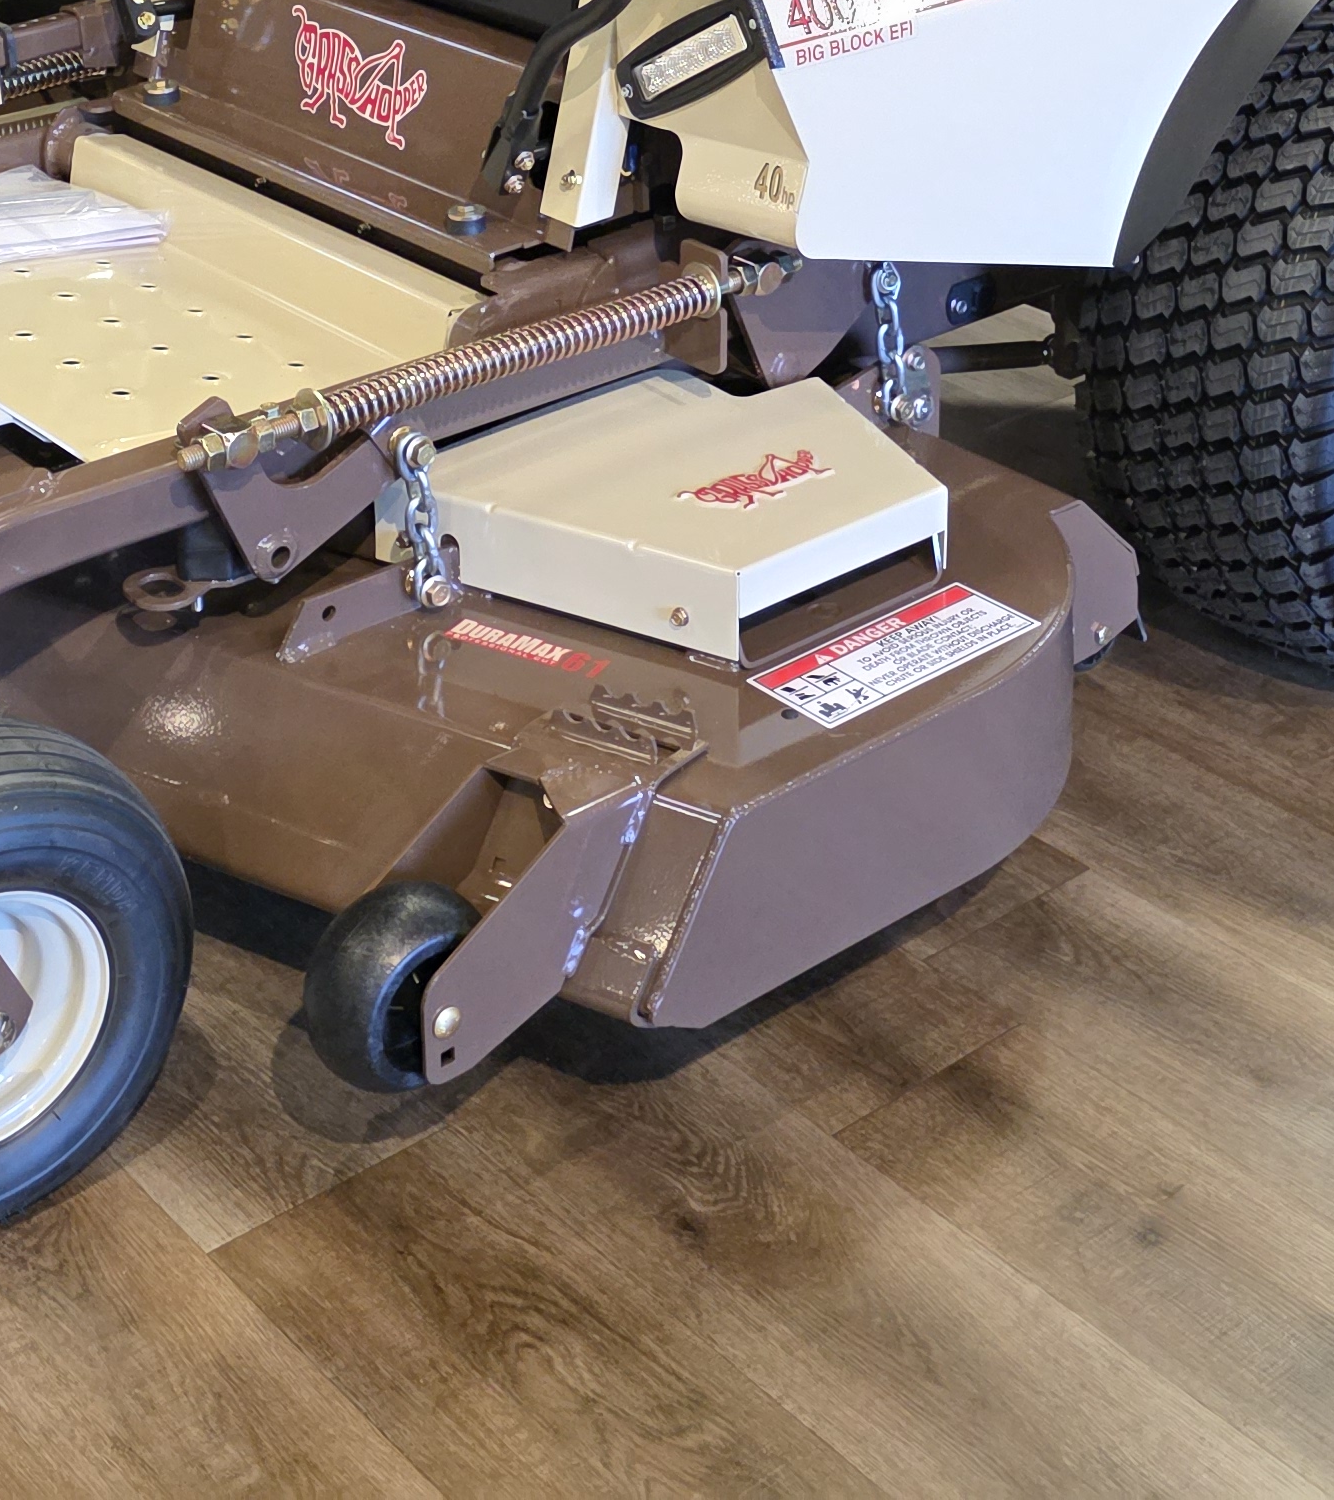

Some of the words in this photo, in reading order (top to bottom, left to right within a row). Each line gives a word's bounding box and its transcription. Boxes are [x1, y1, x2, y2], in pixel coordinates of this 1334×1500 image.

[796, 44, 825, 66] BIG
[829, 27, 885, 57] BLOCK
[889, 19, 913, 41] EFI
[293, 11, 428, 140] GRASSHOPPER
[444, 631, 534, 659] PROFESSIONAL
[533, 655, 556, 666] CUT
[829, 617, 907, 656] DANGER
[856, 656, 872, 665] TO
[872, 643, 899, 659] AVOID
[898, 627, 934, 644] SERIOUS
[932, 613, 961, 629] INJURY
[960, 607, 975, 616] OR
[862, 656, 892, 672] DEATH
[889, 643, 917, 657] FROM
[915, 626, 953, 645] THROWN
[951, 610, 988, 629] OBJECTS
[867, 670, 899, 687] NEVER
[896, 653, 934, 672] OPERATE
[932, 635, 969, 655] WITHOUT
[967, 613, 1015, 638] DISCHARGE
[876, 631, 903, 647] KEEP
[905, 615, 941, 634] AWAY!
[893, 656, 910, 665] OR
[906, 643, 936, 658] BLADE
[561, 652, 611, 679] 61
[885, 671, 915, 687] CHUTE
[913, 664, 929, 673] OR
[926, 655, 948, 667] SIDE
[945, 640, 979, 657] SHIELDS
